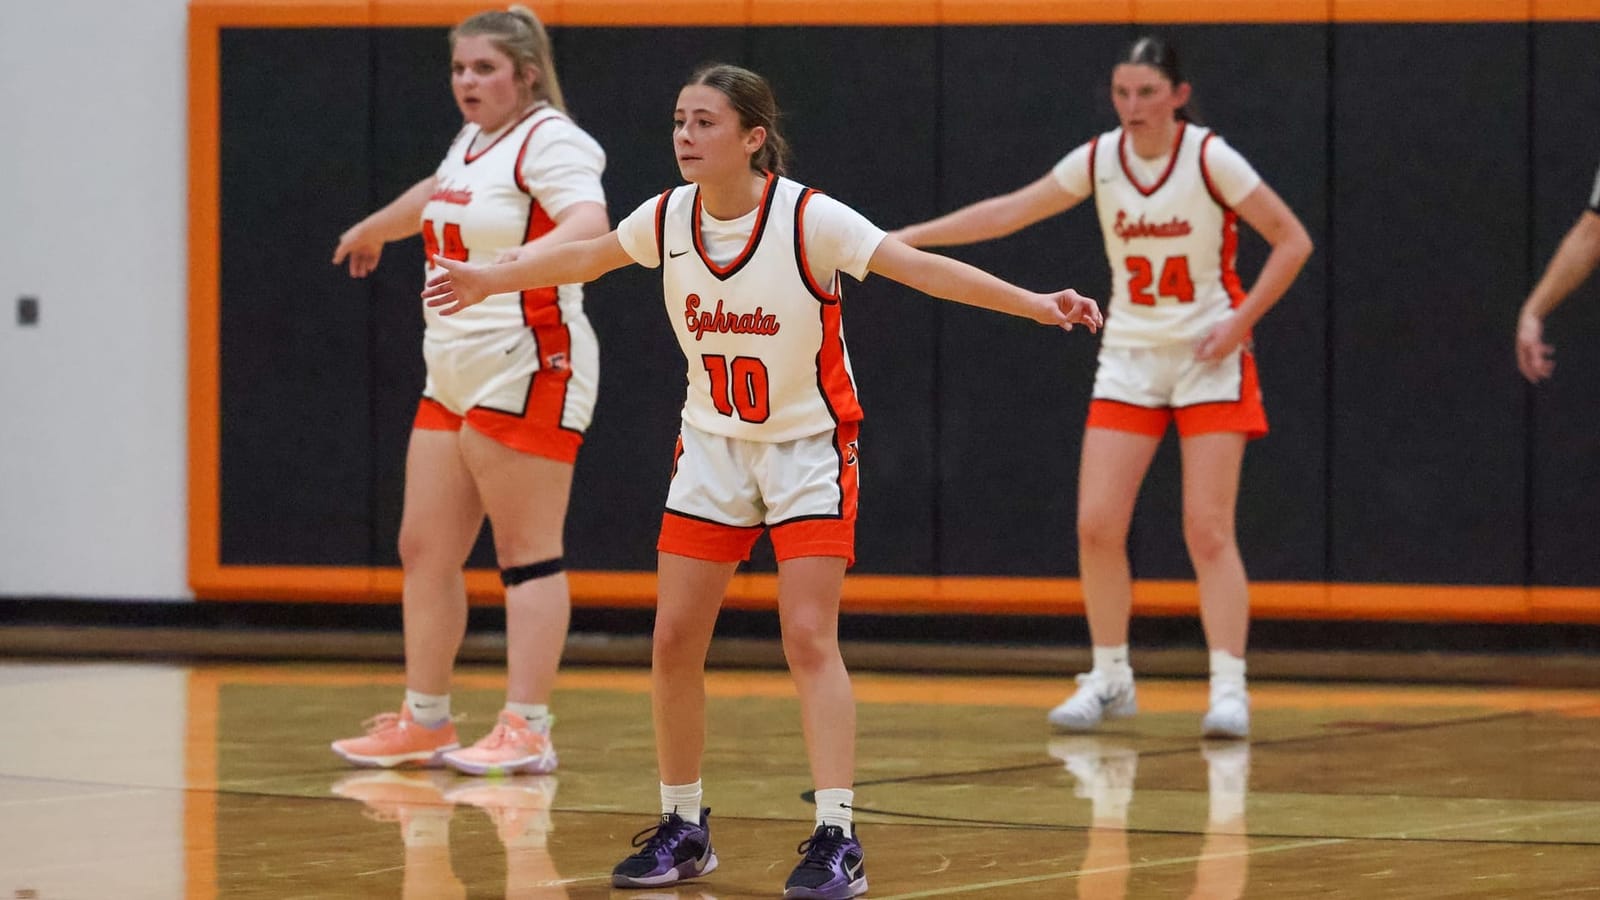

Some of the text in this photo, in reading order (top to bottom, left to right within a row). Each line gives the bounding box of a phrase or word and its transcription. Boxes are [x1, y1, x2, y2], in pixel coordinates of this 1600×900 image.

[1125, 255, 1195, 306] 24
[685, 293, 780, 341] Ephrata
[701, 353, 770, 424] 10
